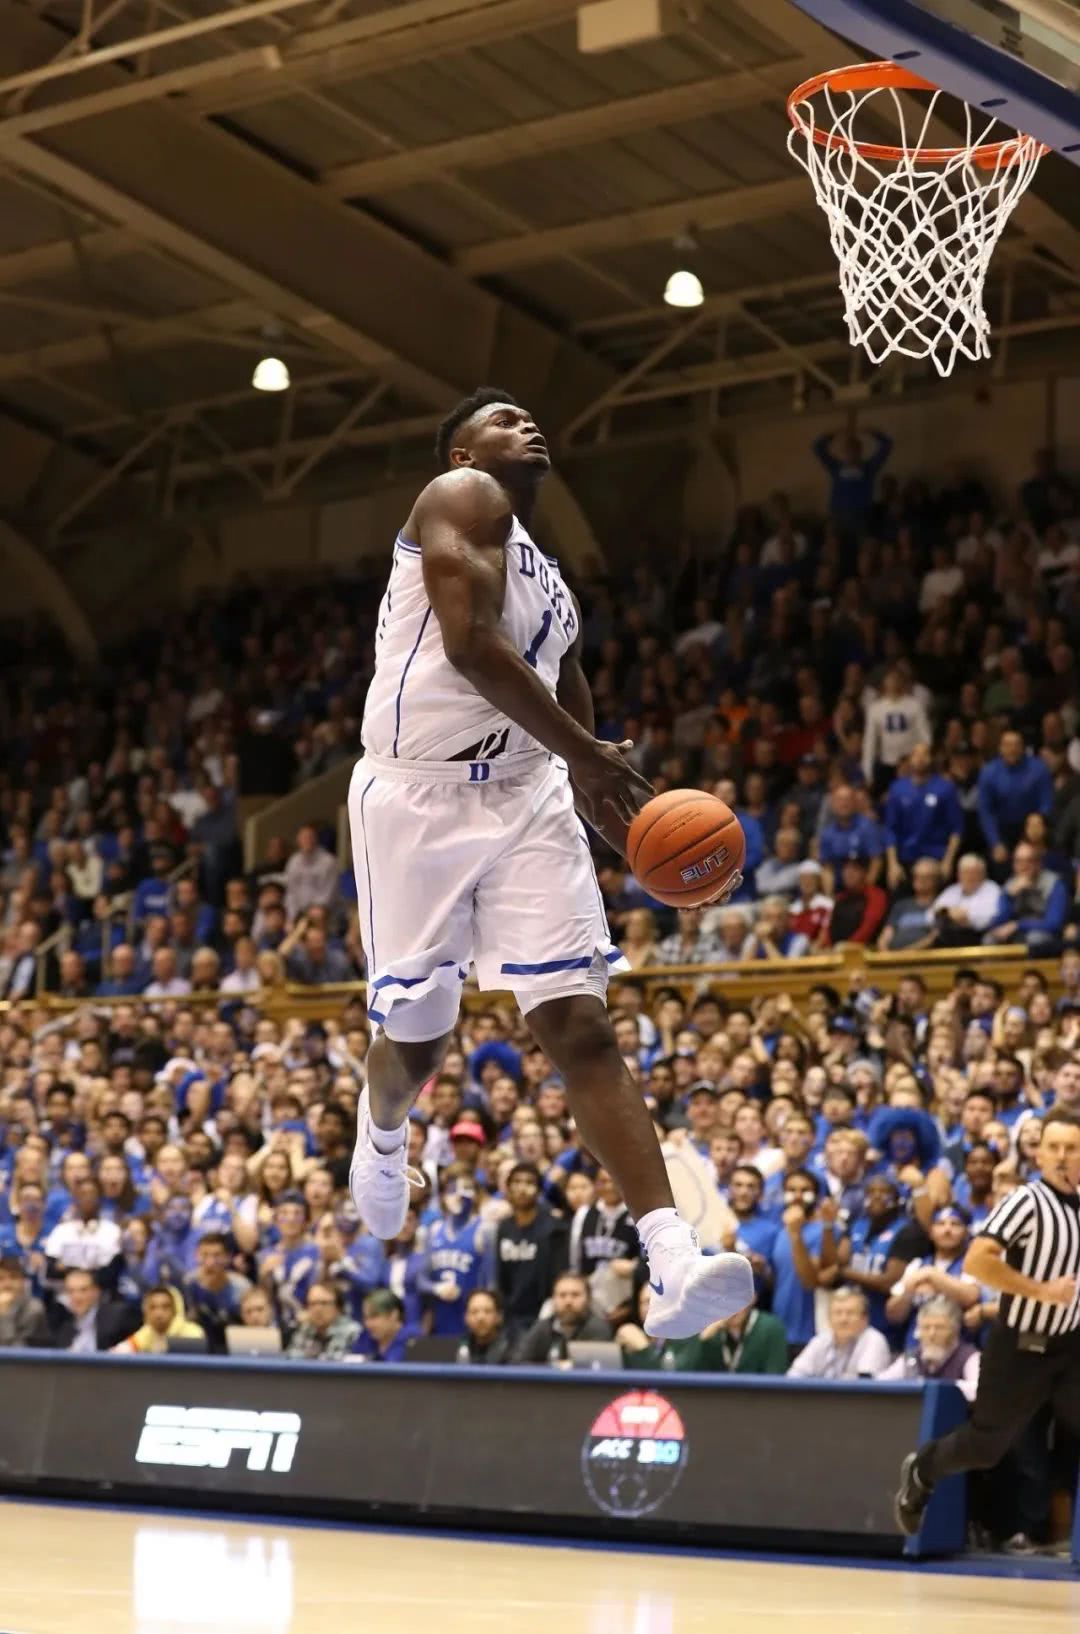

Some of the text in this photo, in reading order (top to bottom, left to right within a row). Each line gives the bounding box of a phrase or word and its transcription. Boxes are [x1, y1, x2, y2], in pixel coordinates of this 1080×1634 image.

[523, 609, 553, 669] 1
[468, 762, 490, 782] D
[680, 846, 729, 884] ELITE
[135, 1405, 301, 1472] ESPN
